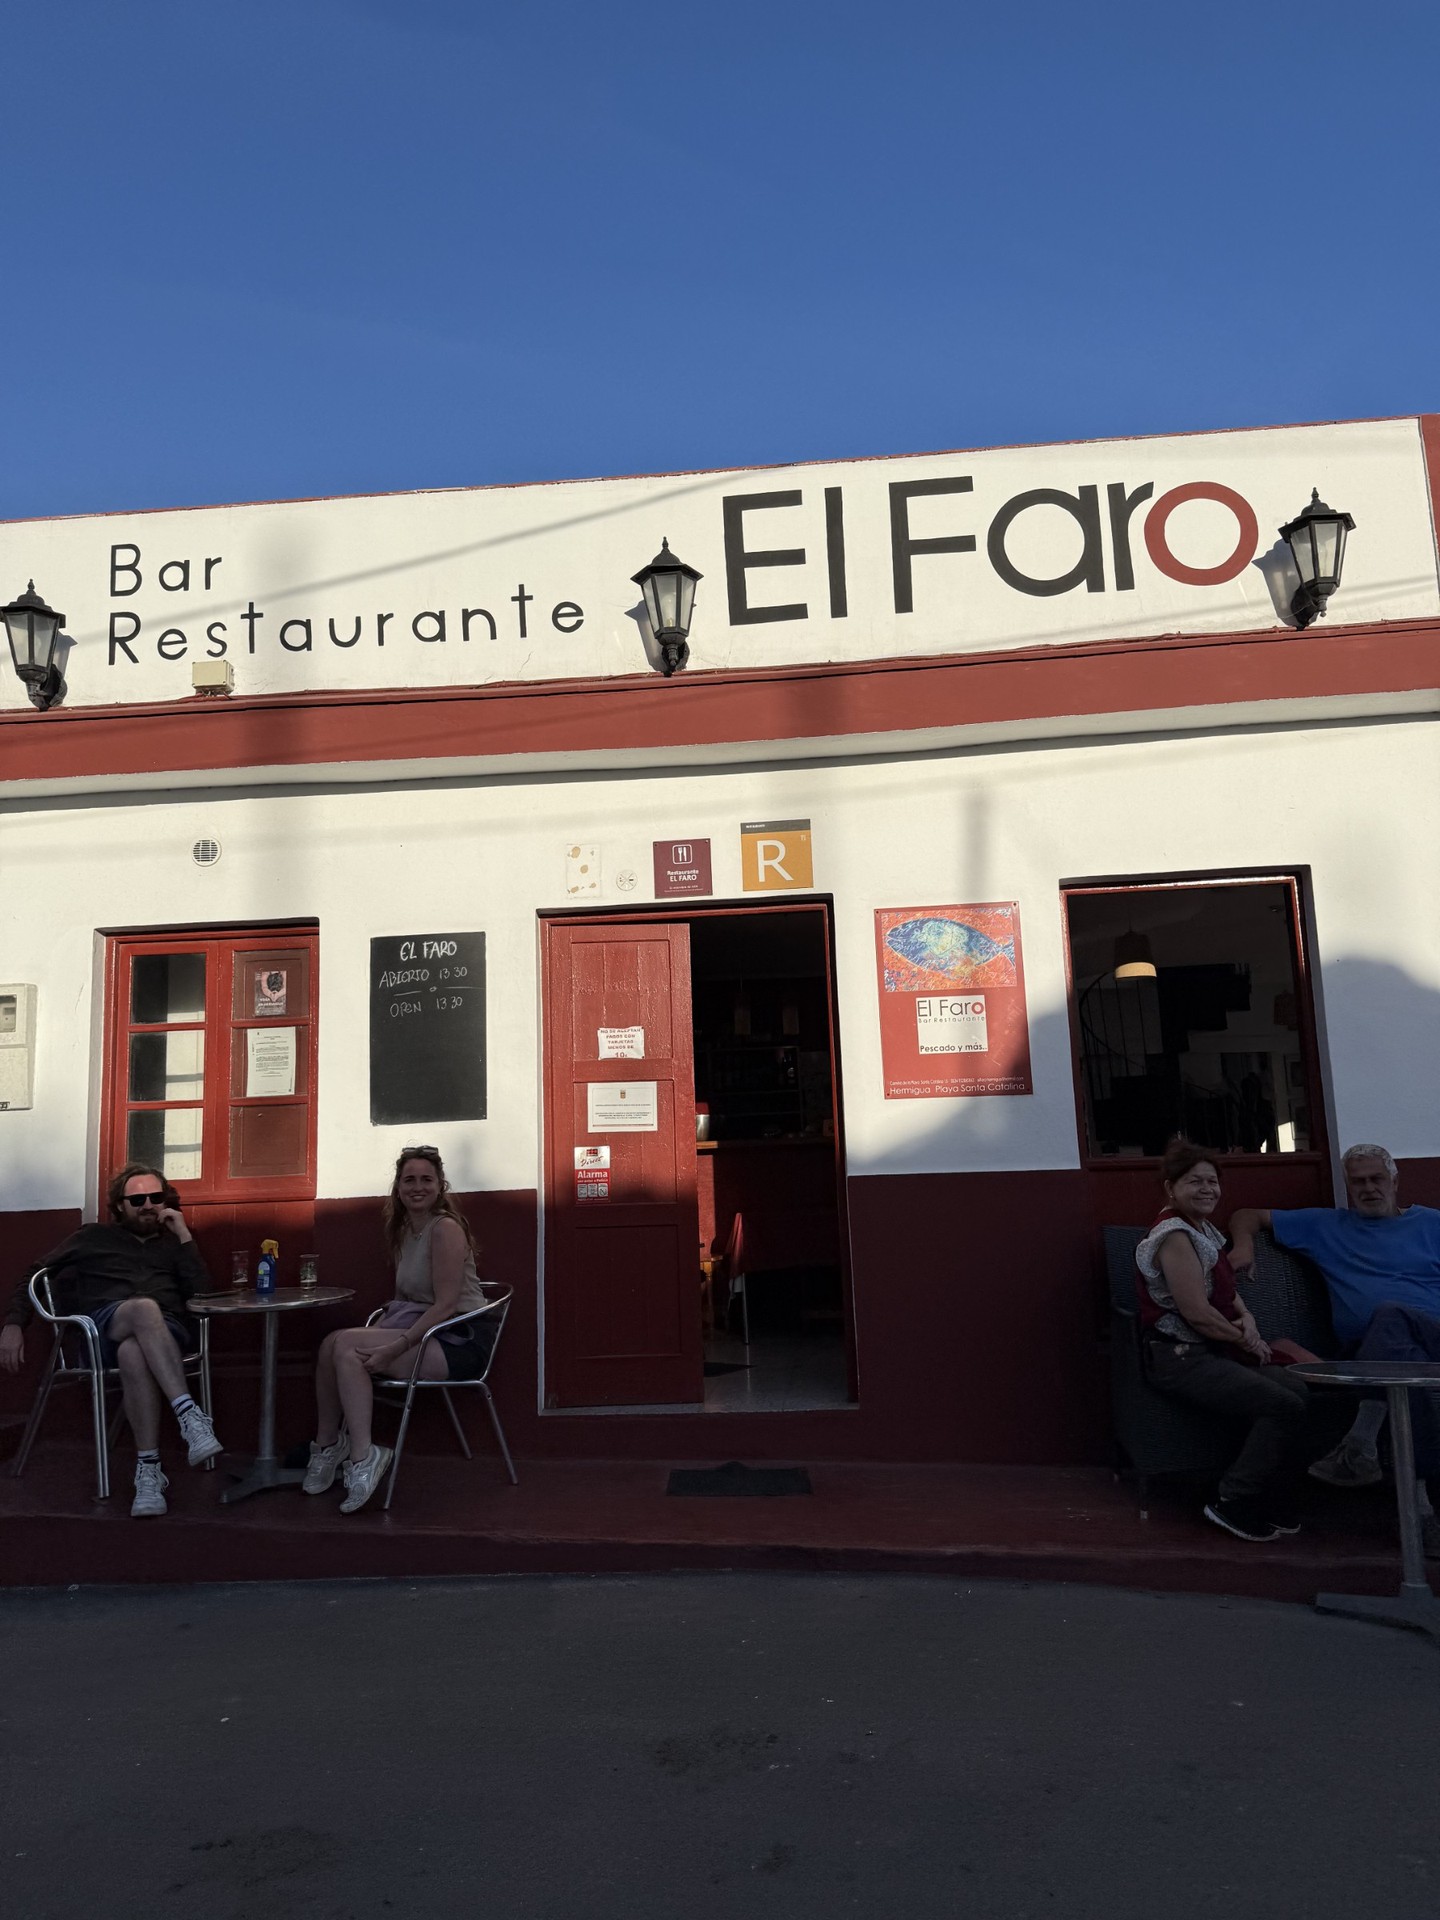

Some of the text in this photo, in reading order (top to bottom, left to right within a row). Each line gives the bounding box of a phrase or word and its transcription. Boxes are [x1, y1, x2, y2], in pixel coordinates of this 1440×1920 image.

[723, 475, 1258, 626] El Faro
[109, 543, 223, 597] Bar
[108, 583, 585, 666] Restaurante
[757, 840, 794, 882] R
[400, 941, 457, 961] EL FARO
[379, 968, 429, 988] ABIERTO
[390, 1002, 421, 1017] OPEN
[917, 999, 984, 1016] El Faro
[920, 1044, 956, 1052] Pescado
[890, 1082, 1025, 1096] Hermigua Playa Santa Catalina
[577, 1170, 608, 1179] Alarma
